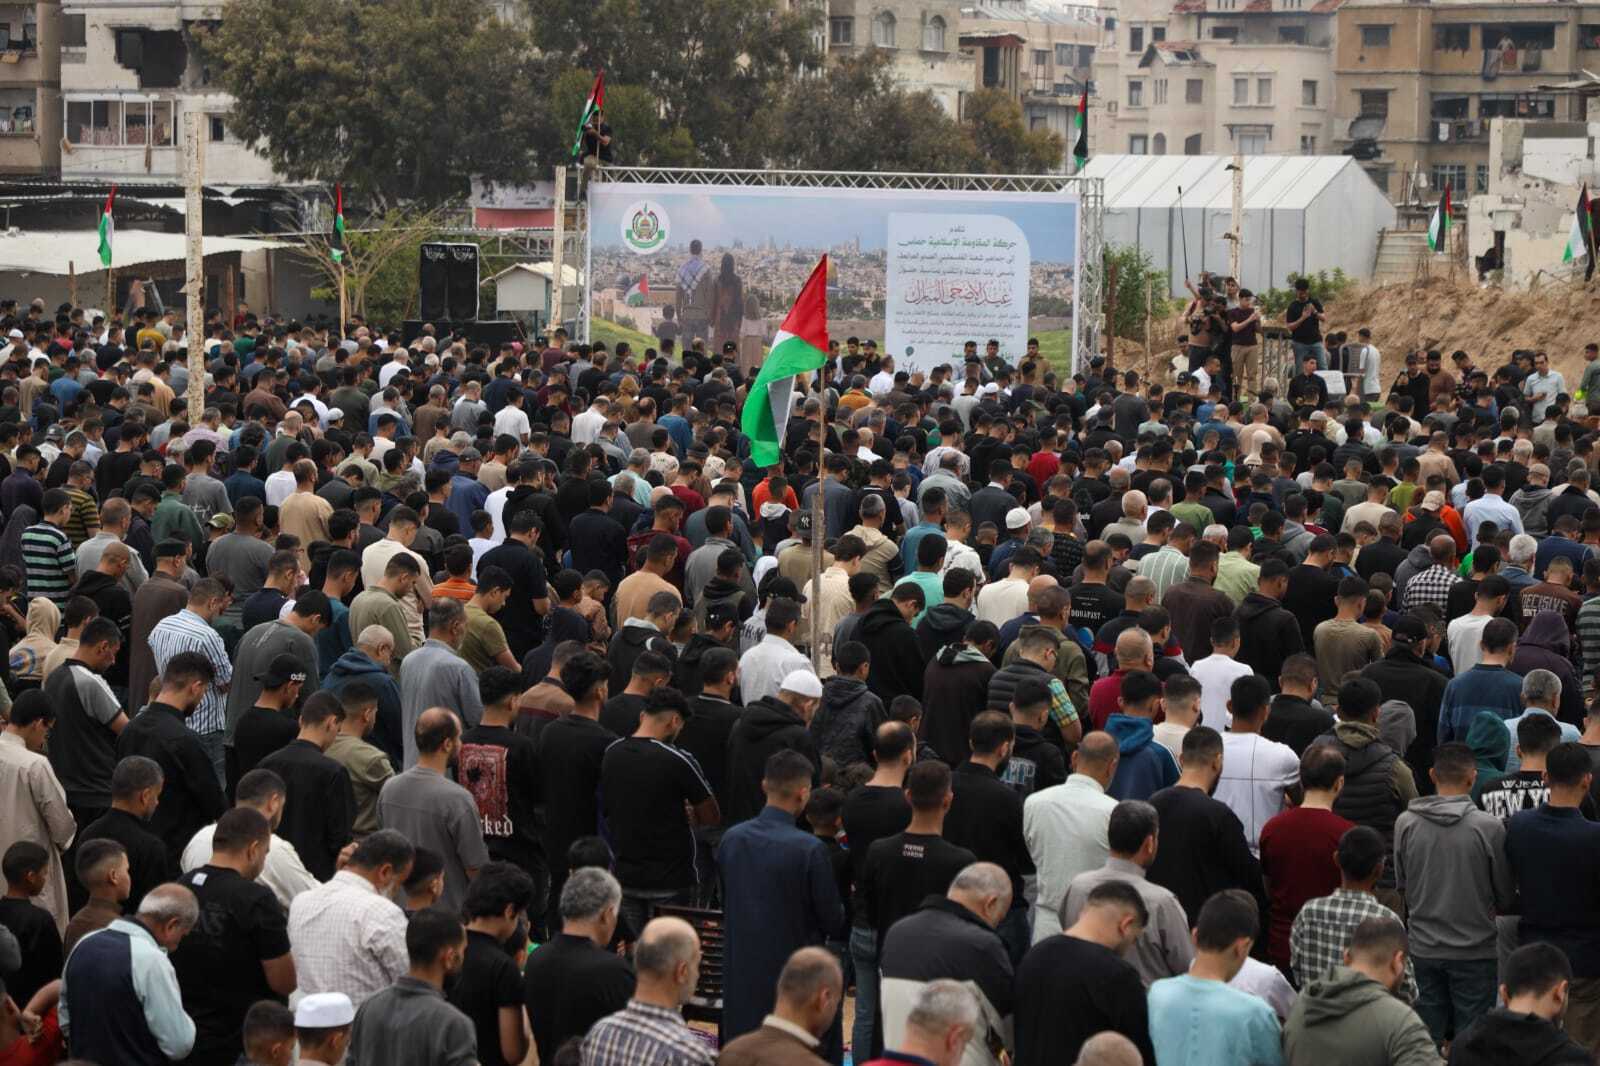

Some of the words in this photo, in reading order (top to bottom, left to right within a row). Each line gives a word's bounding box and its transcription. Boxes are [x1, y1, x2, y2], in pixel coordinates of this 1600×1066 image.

[897, 236, 926, 247] حماس
[962, 237, 990, 249] المقاومة
[991, 237, 1016, 250] حركة
[904, 279, 944, 305] المبارك
[976, 282, 1012, 308] عيد
[480, 813, 513, 836] ked
